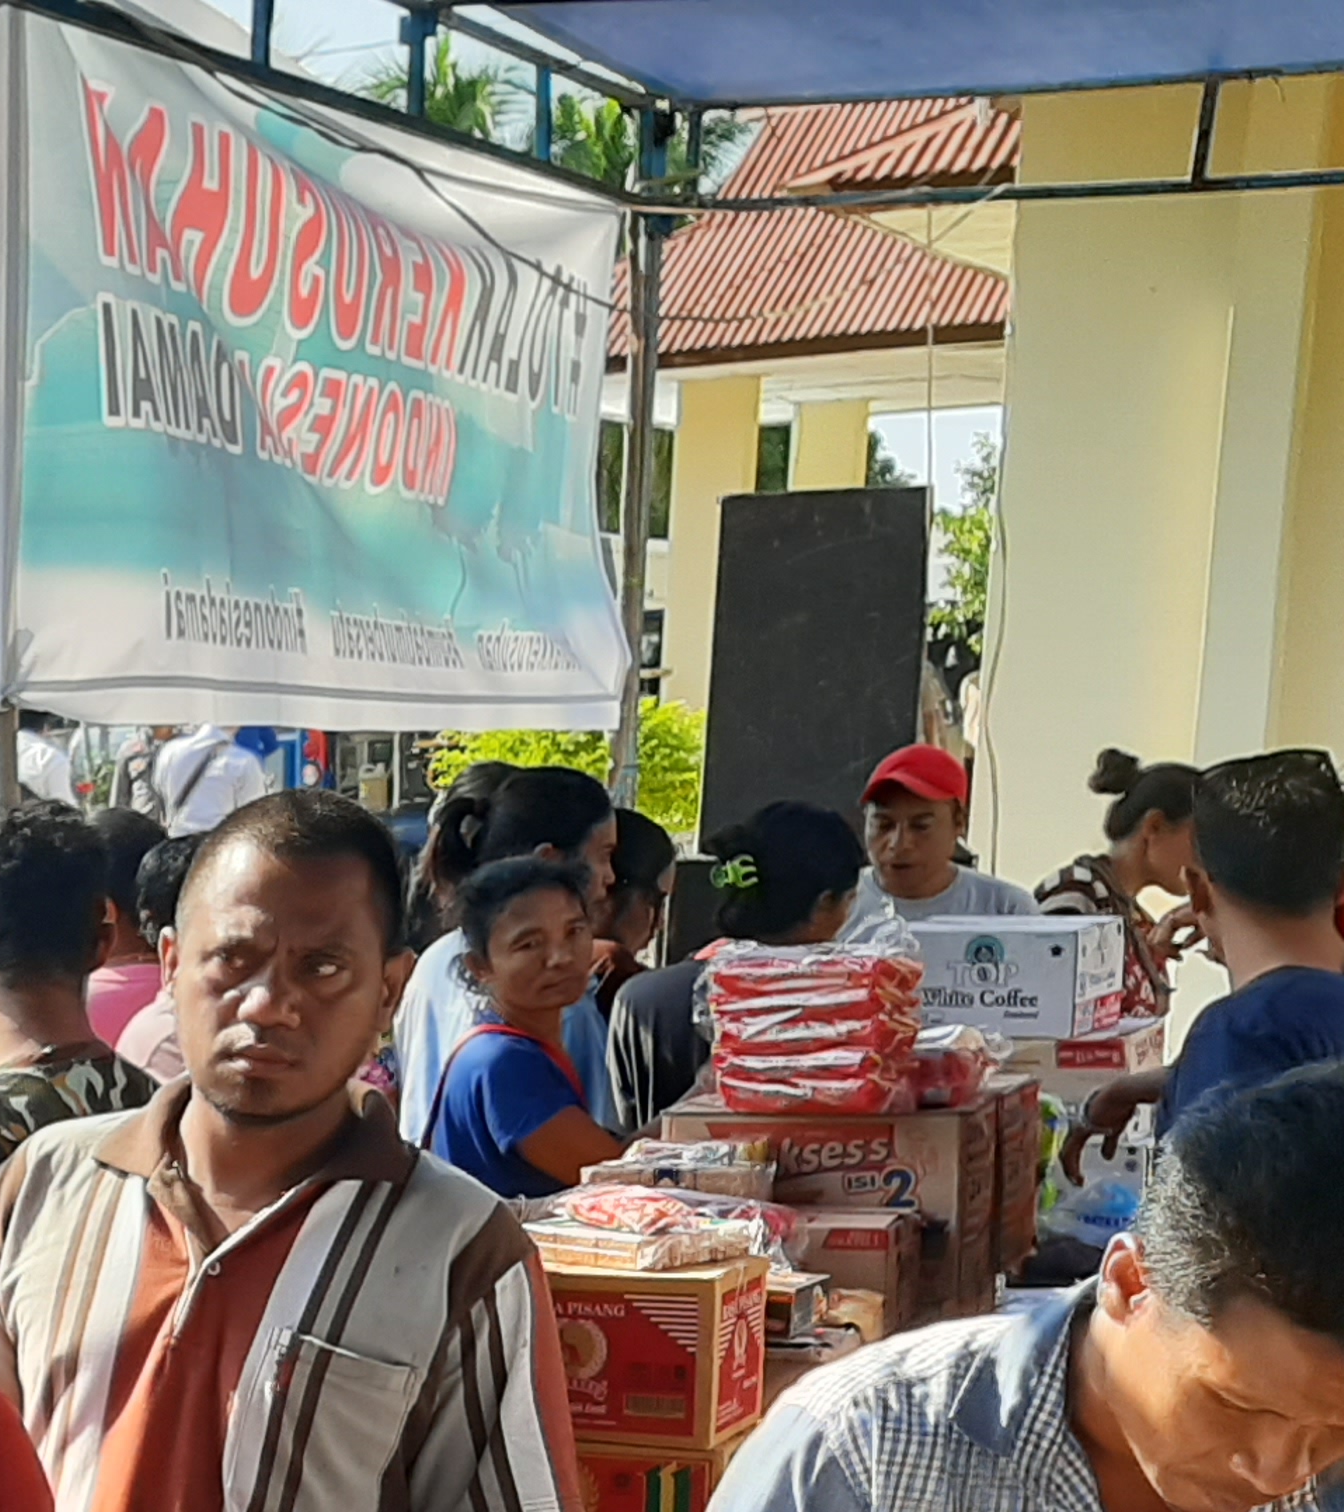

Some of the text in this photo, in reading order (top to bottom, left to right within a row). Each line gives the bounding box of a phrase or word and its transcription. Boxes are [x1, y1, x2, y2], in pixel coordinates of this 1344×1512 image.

[947, 961, 1019, 988] TOP
[979, 989, 1039, 1008] Coffee
[846, 1168, 916, 1207] ISI 2
[567, 1302, 626, 1318] PISANG
